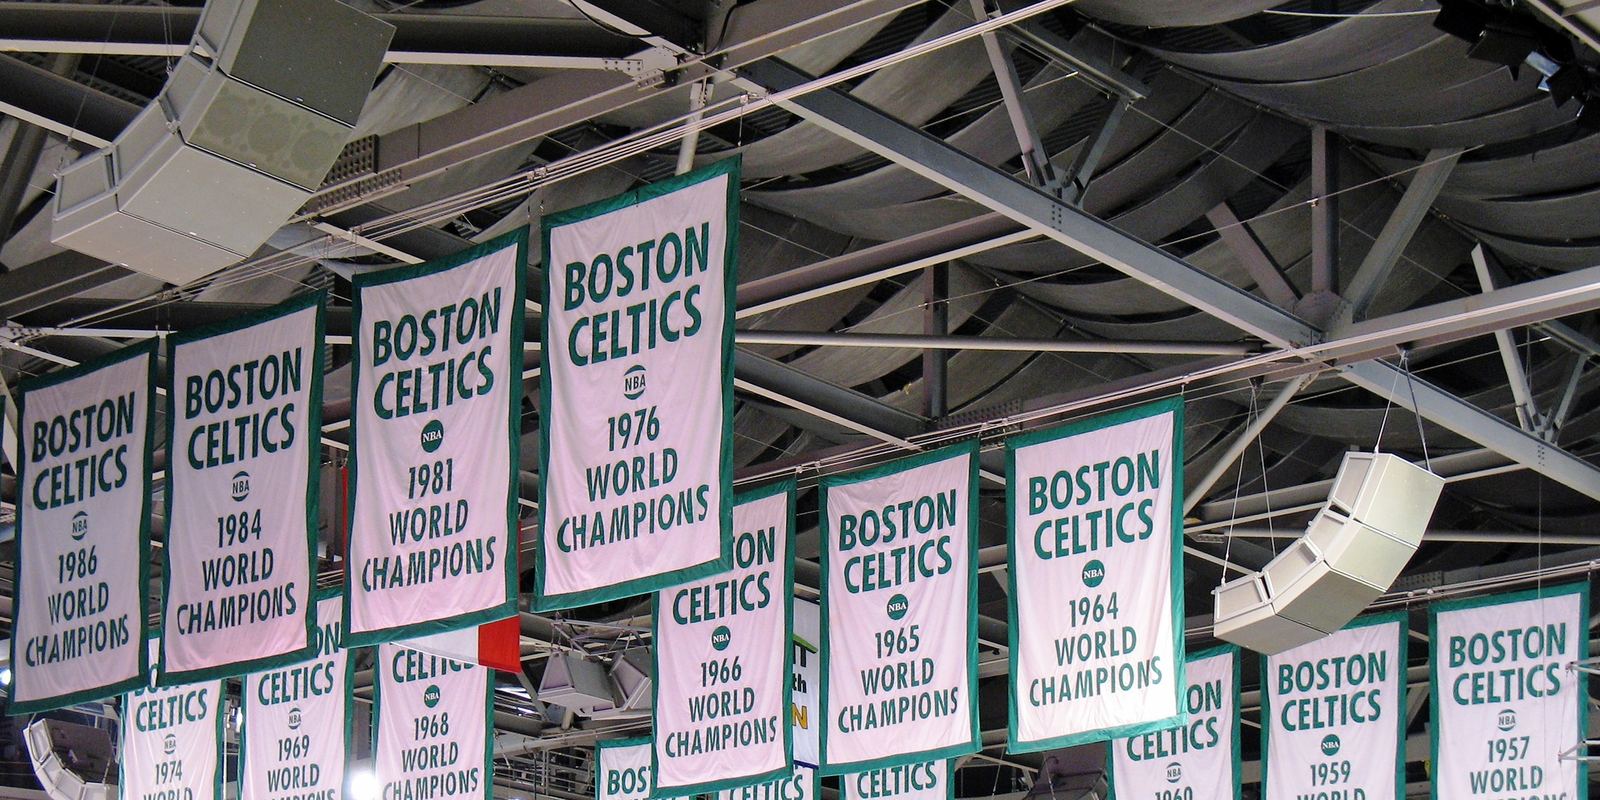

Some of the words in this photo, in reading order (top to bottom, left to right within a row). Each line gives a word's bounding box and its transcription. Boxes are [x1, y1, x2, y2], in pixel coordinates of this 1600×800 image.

[564, 221, 709, 311] BOSTON
[373, 287, 501, 367] BOSTON
[568, 284, 702, 367] CELTICS
[185, 347, 302, 420] BOSTON
[374, 345, 494, 420] CELTICS
[625, 375, 646, 391] NBA
[31, 391, 135, 463] BOSTON
[188, 403, 295, 470] CELTICS
[422, 429, 443, 442] NBA
[608, 405, 660, 452] 1976
[33, 444, 127, 511] CELTICS
[232, 481, 250, 494] NBA
[409, 458, 453, 499] 1981
[586, 448, 678, 502] WORLD
[1029, 449, 1159, 516] BOSTON
[72, 520, 87, 533] NBA
[218, 509, 261, 548] 1984
[389, 499, 468, 546] WORLD
[556, 484, 709, 553] CHAMPIONS
[839, 489, 956, 551] BOSTON
[1034, 498, 1153, 560] CELTICS
[58, 545, 97, 584] 1986
[202, 548, 273, 591] WORLD
[362, 536, 496, 592] CHAMPIONS
[844, 535, 952, 594] CELTICS
[1083, 568, 1104, 579] NBA
[48, 582, 109, 625] WORLD
[177, 582, 296, 635] CHAMPIONS
[673, 571, 770, 625] CELTICS
[889, 603, 906, 612] NBA
[1069, 592, 1118, 628] 1964
[25, 614, 129, 667] CHAMPIONS
[713, 633, 730, 643] NBA
[875, 625, 919, 659] 1965
[1054, 626, 1137, 666] WORLD
[1449, 622, 1566, 668] BOSTON
[258, 661, 335, 706] CELTICS
[701, 656, 742, 687] 1966
[861, 658, 934, 696] WORLD
[1029, 656, 1162, 707] CHAMPIONS
[1278, 650, 1386, 695] BOSTON
[1453, 662, 1560, 706] CELTICS
[136, 688, 207, 732] CELTICS
[425, 692, 439, 701] NBA
[688, 687, 755, 722] WORLD
[838, 686, 958, 733] CHAMPIONS
[1281, 689, 1381, 732] CELTICS
[289, 714, 302, 724] NBA
[414, 712, 449, 741] 1968
[665, 716, 777, 758] CHAMPIONS
[1127, 716, 1219, 761] CELTICS
[1499, 715, 1515, 725] NBA
[164, 740, 176, 749] NBA
[278, 734, 310, 762] 1969
[402, 741, 458, 773] WORLD
[1322, 741, 1339, 749] NBA
[1488, 736, 1530, 763] 1957
[156, 760, 182, 785] 1974
[267, 763, 320, 792] WORLD
[384, 767, 478, 800] CHAMPIONS
[857, 761, 937, 800] CELTICS
[1167, 768, 1181, 778] NBA
[1310, 760, 1351, 787] 1959
[1470, 765, 1543, 794] WORLD
